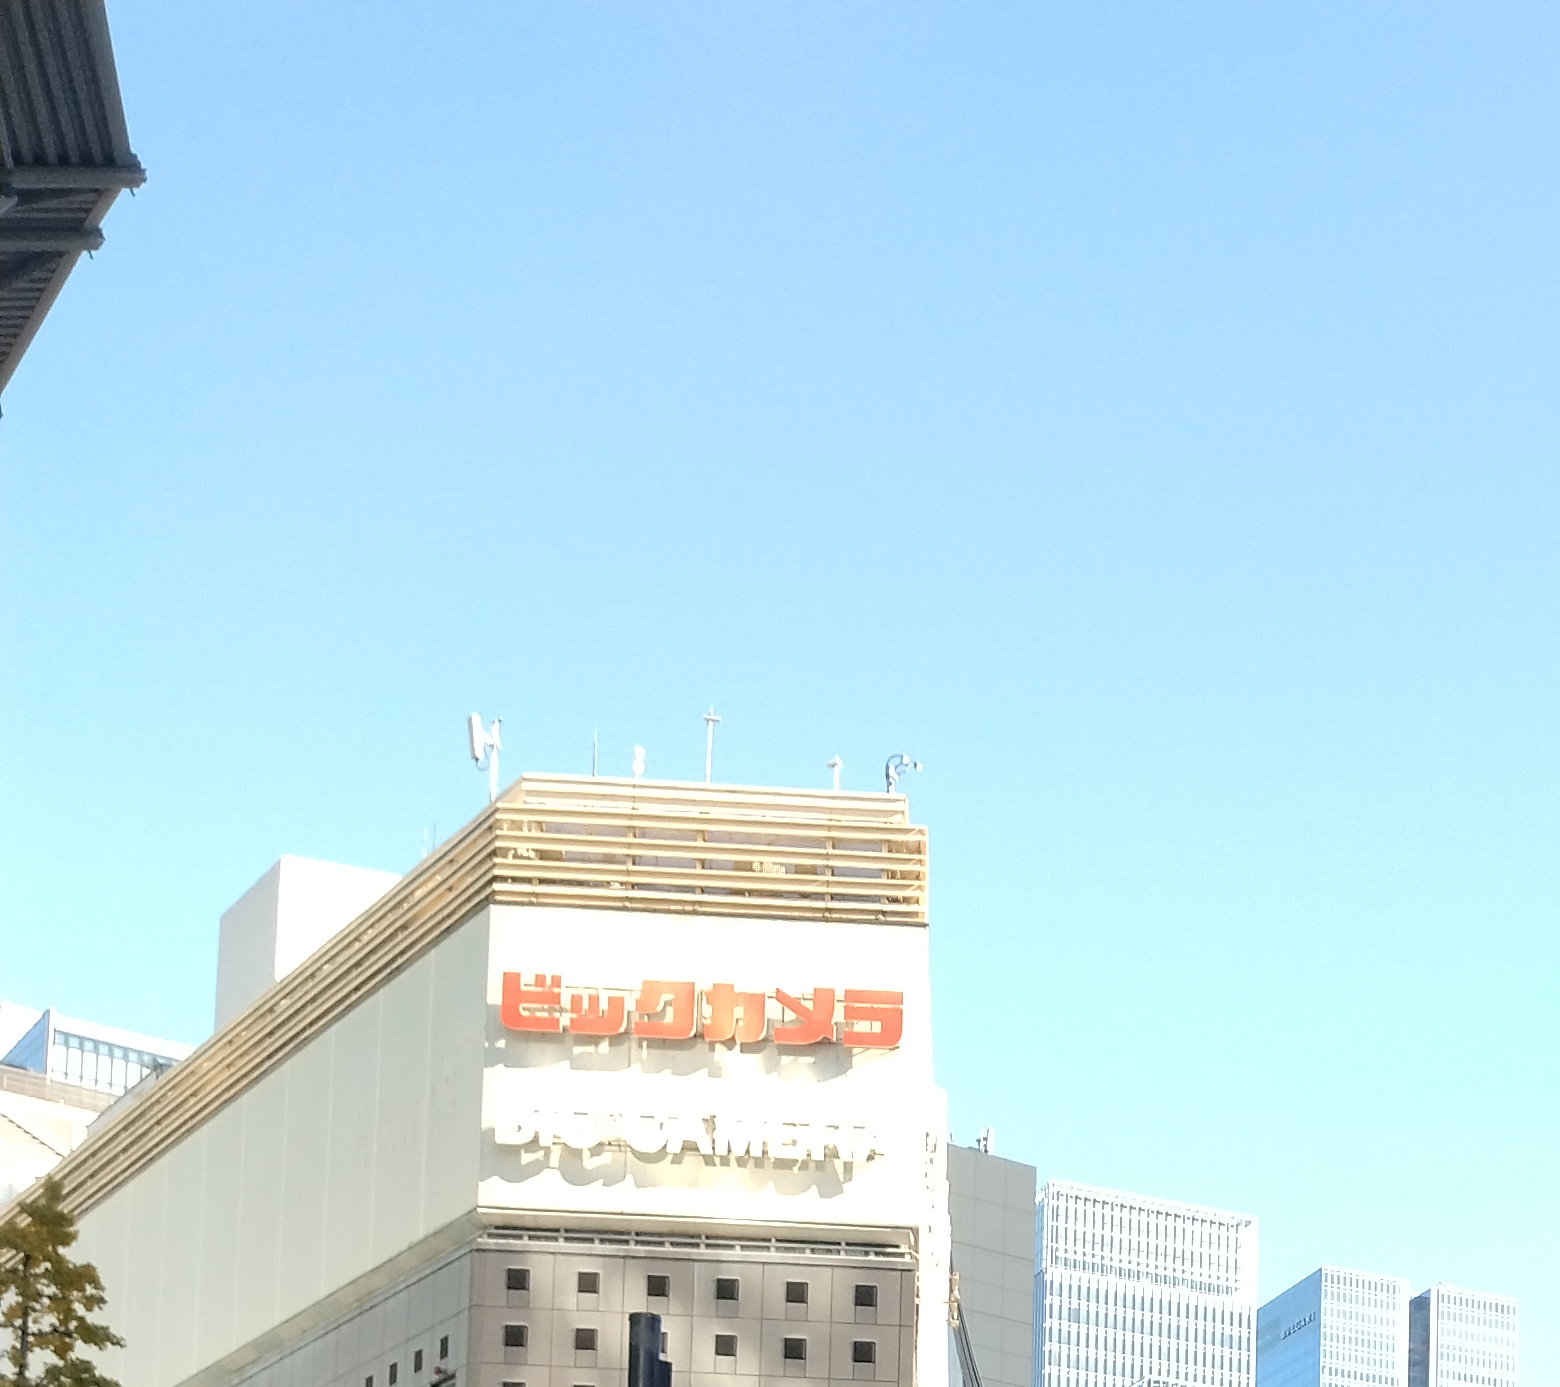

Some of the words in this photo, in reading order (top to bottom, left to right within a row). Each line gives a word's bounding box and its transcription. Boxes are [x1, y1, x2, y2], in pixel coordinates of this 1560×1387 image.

[500, 971, 905, 1050] ビックカメラ
